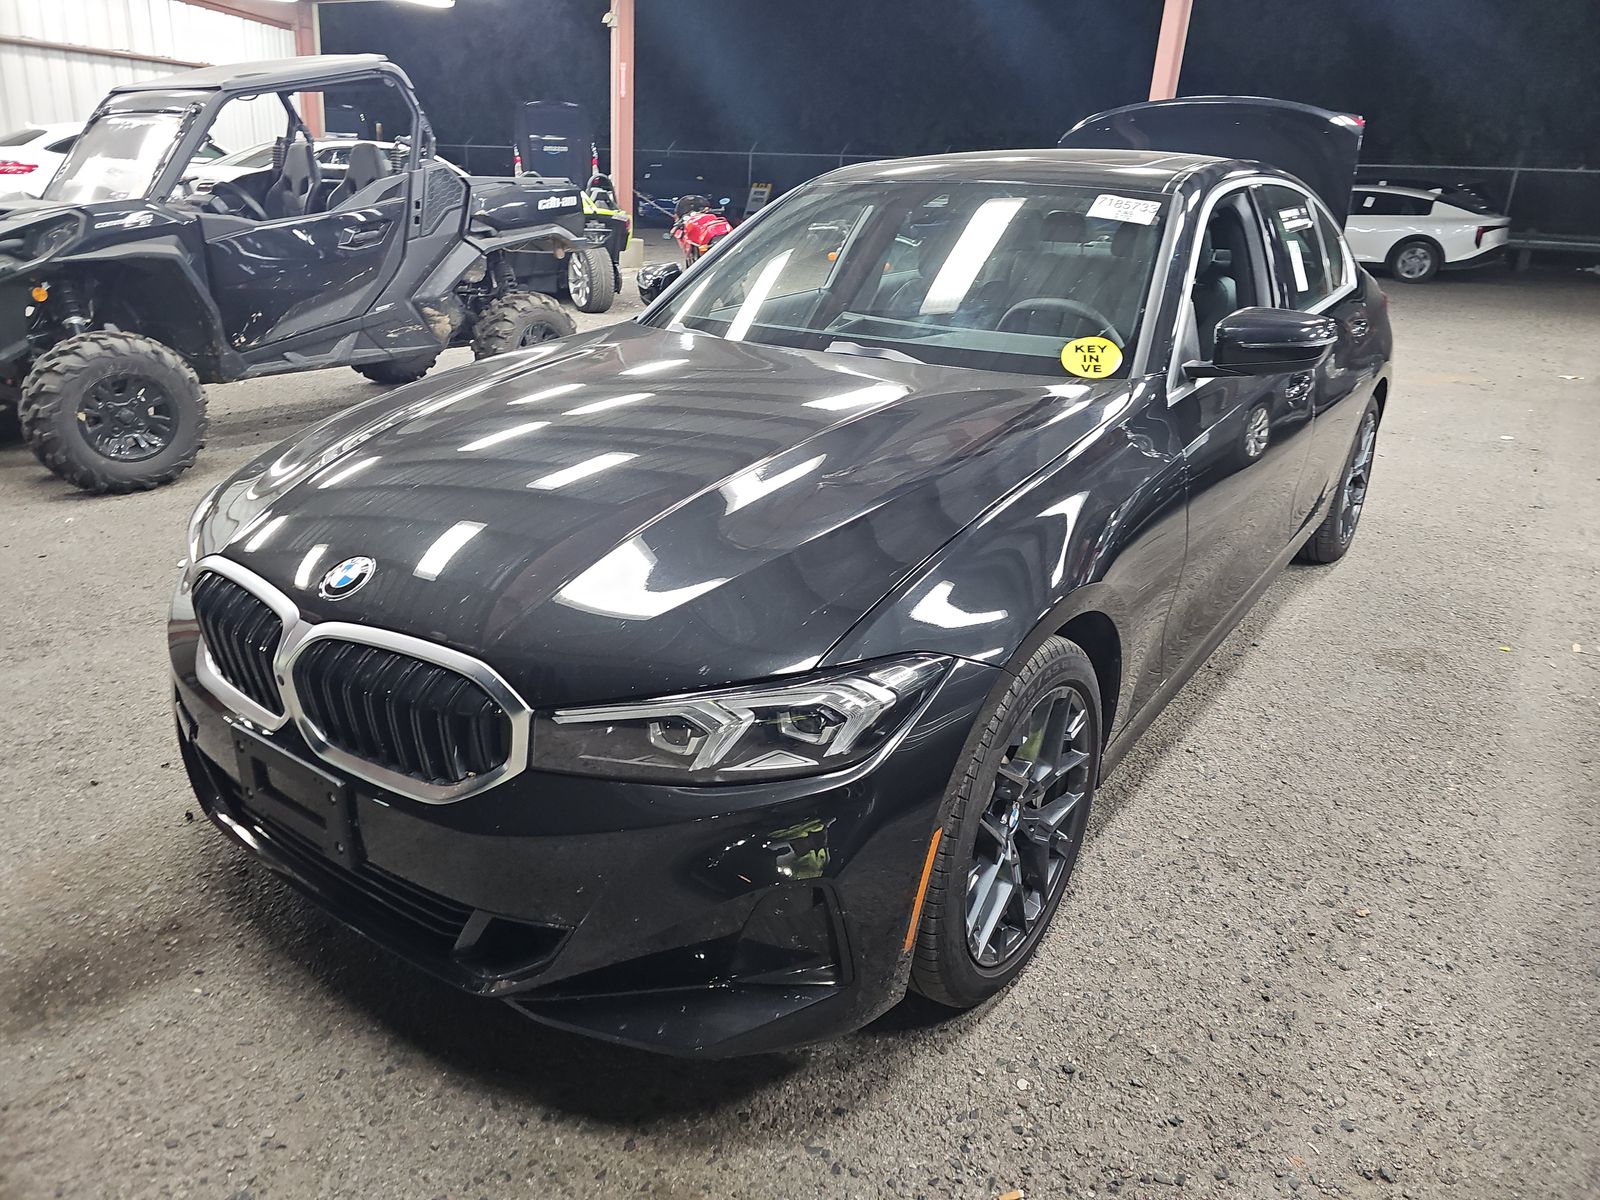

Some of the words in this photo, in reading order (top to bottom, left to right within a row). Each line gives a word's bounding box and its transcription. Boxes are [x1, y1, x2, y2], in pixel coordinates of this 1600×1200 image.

[1098, 196, 1158, 214] 7185733
[1075, 345, 1107, 353] KEY
[1083, 355, 1099, 363] IN
[1081, 364, 1102, 373] VE
